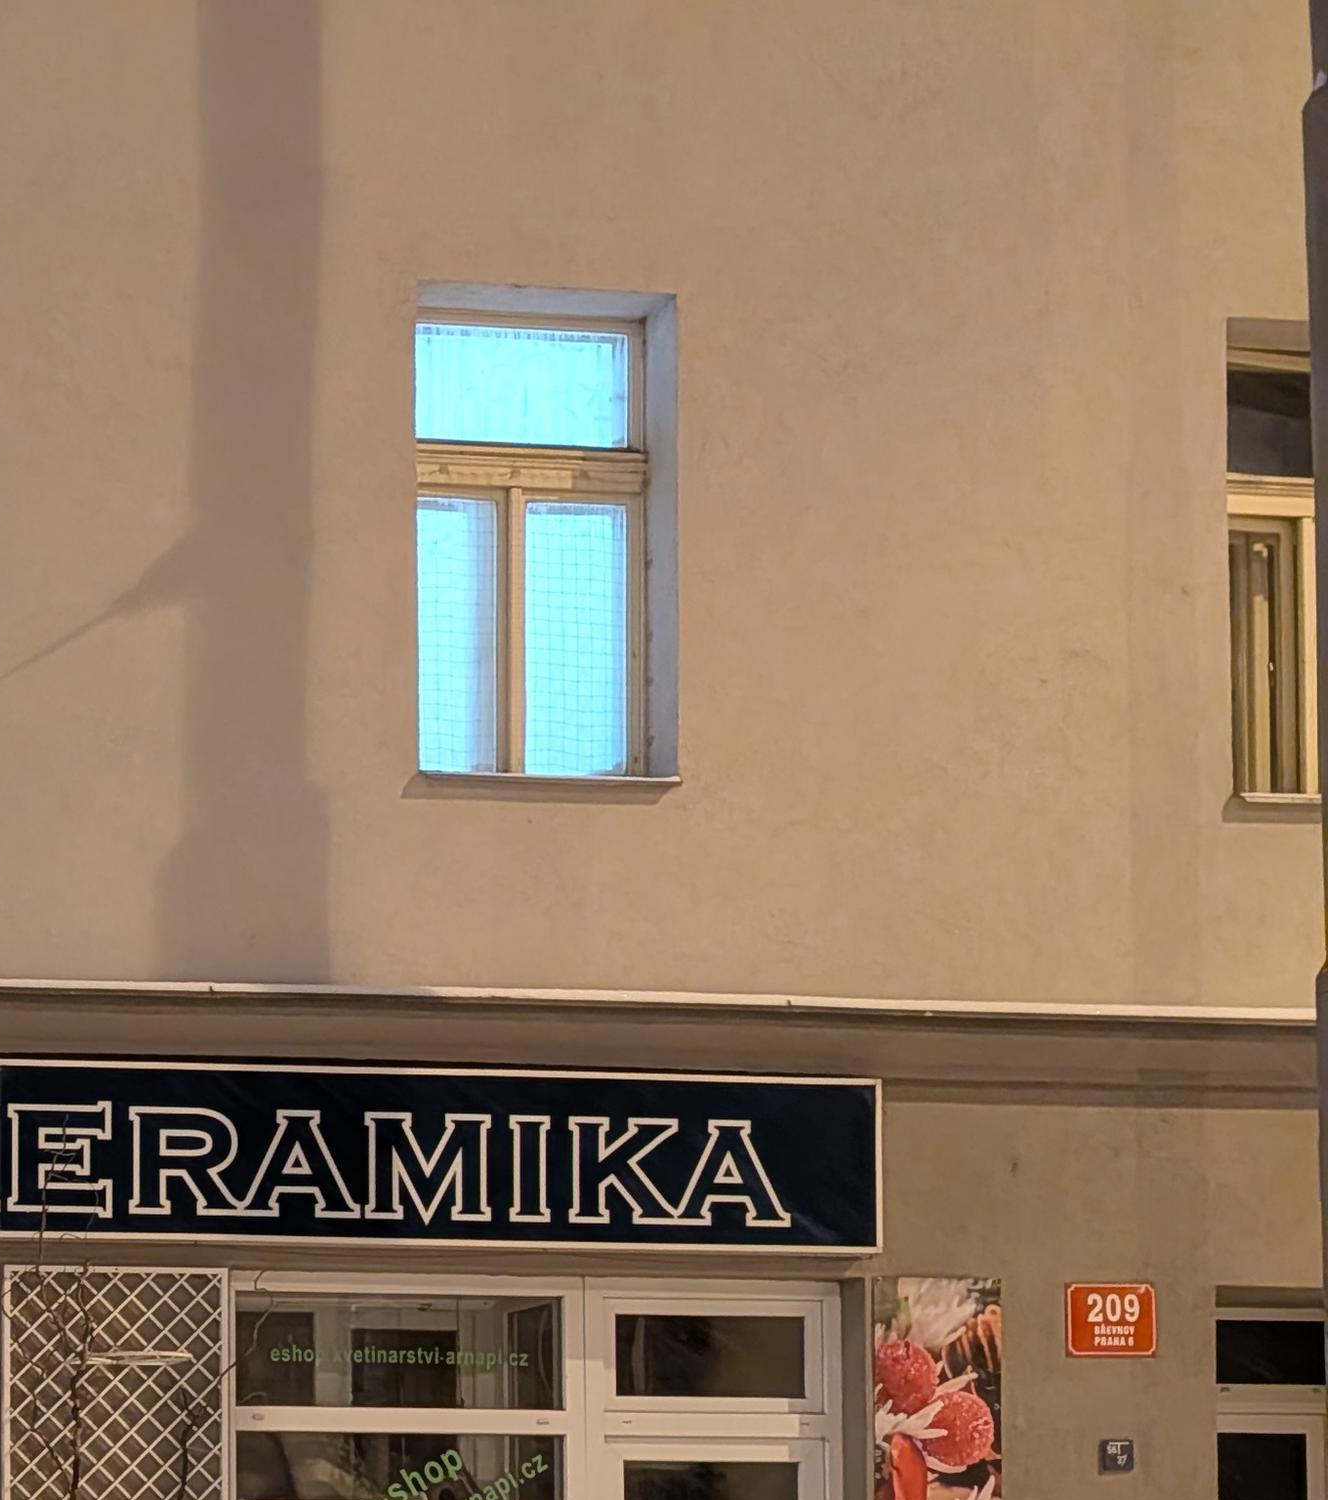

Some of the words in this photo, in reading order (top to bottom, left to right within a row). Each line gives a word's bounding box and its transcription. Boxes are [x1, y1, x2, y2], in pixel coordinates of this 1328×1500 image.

[1087, 1293, 1140, 1323] 209
[1094, 1323, 1135, 1335] BŘEVNOV
[1094, 1336, 1126, 1347] PRAHA
[269, 1344, 529, 1370] eshokvetinarstvi-arnapicz
